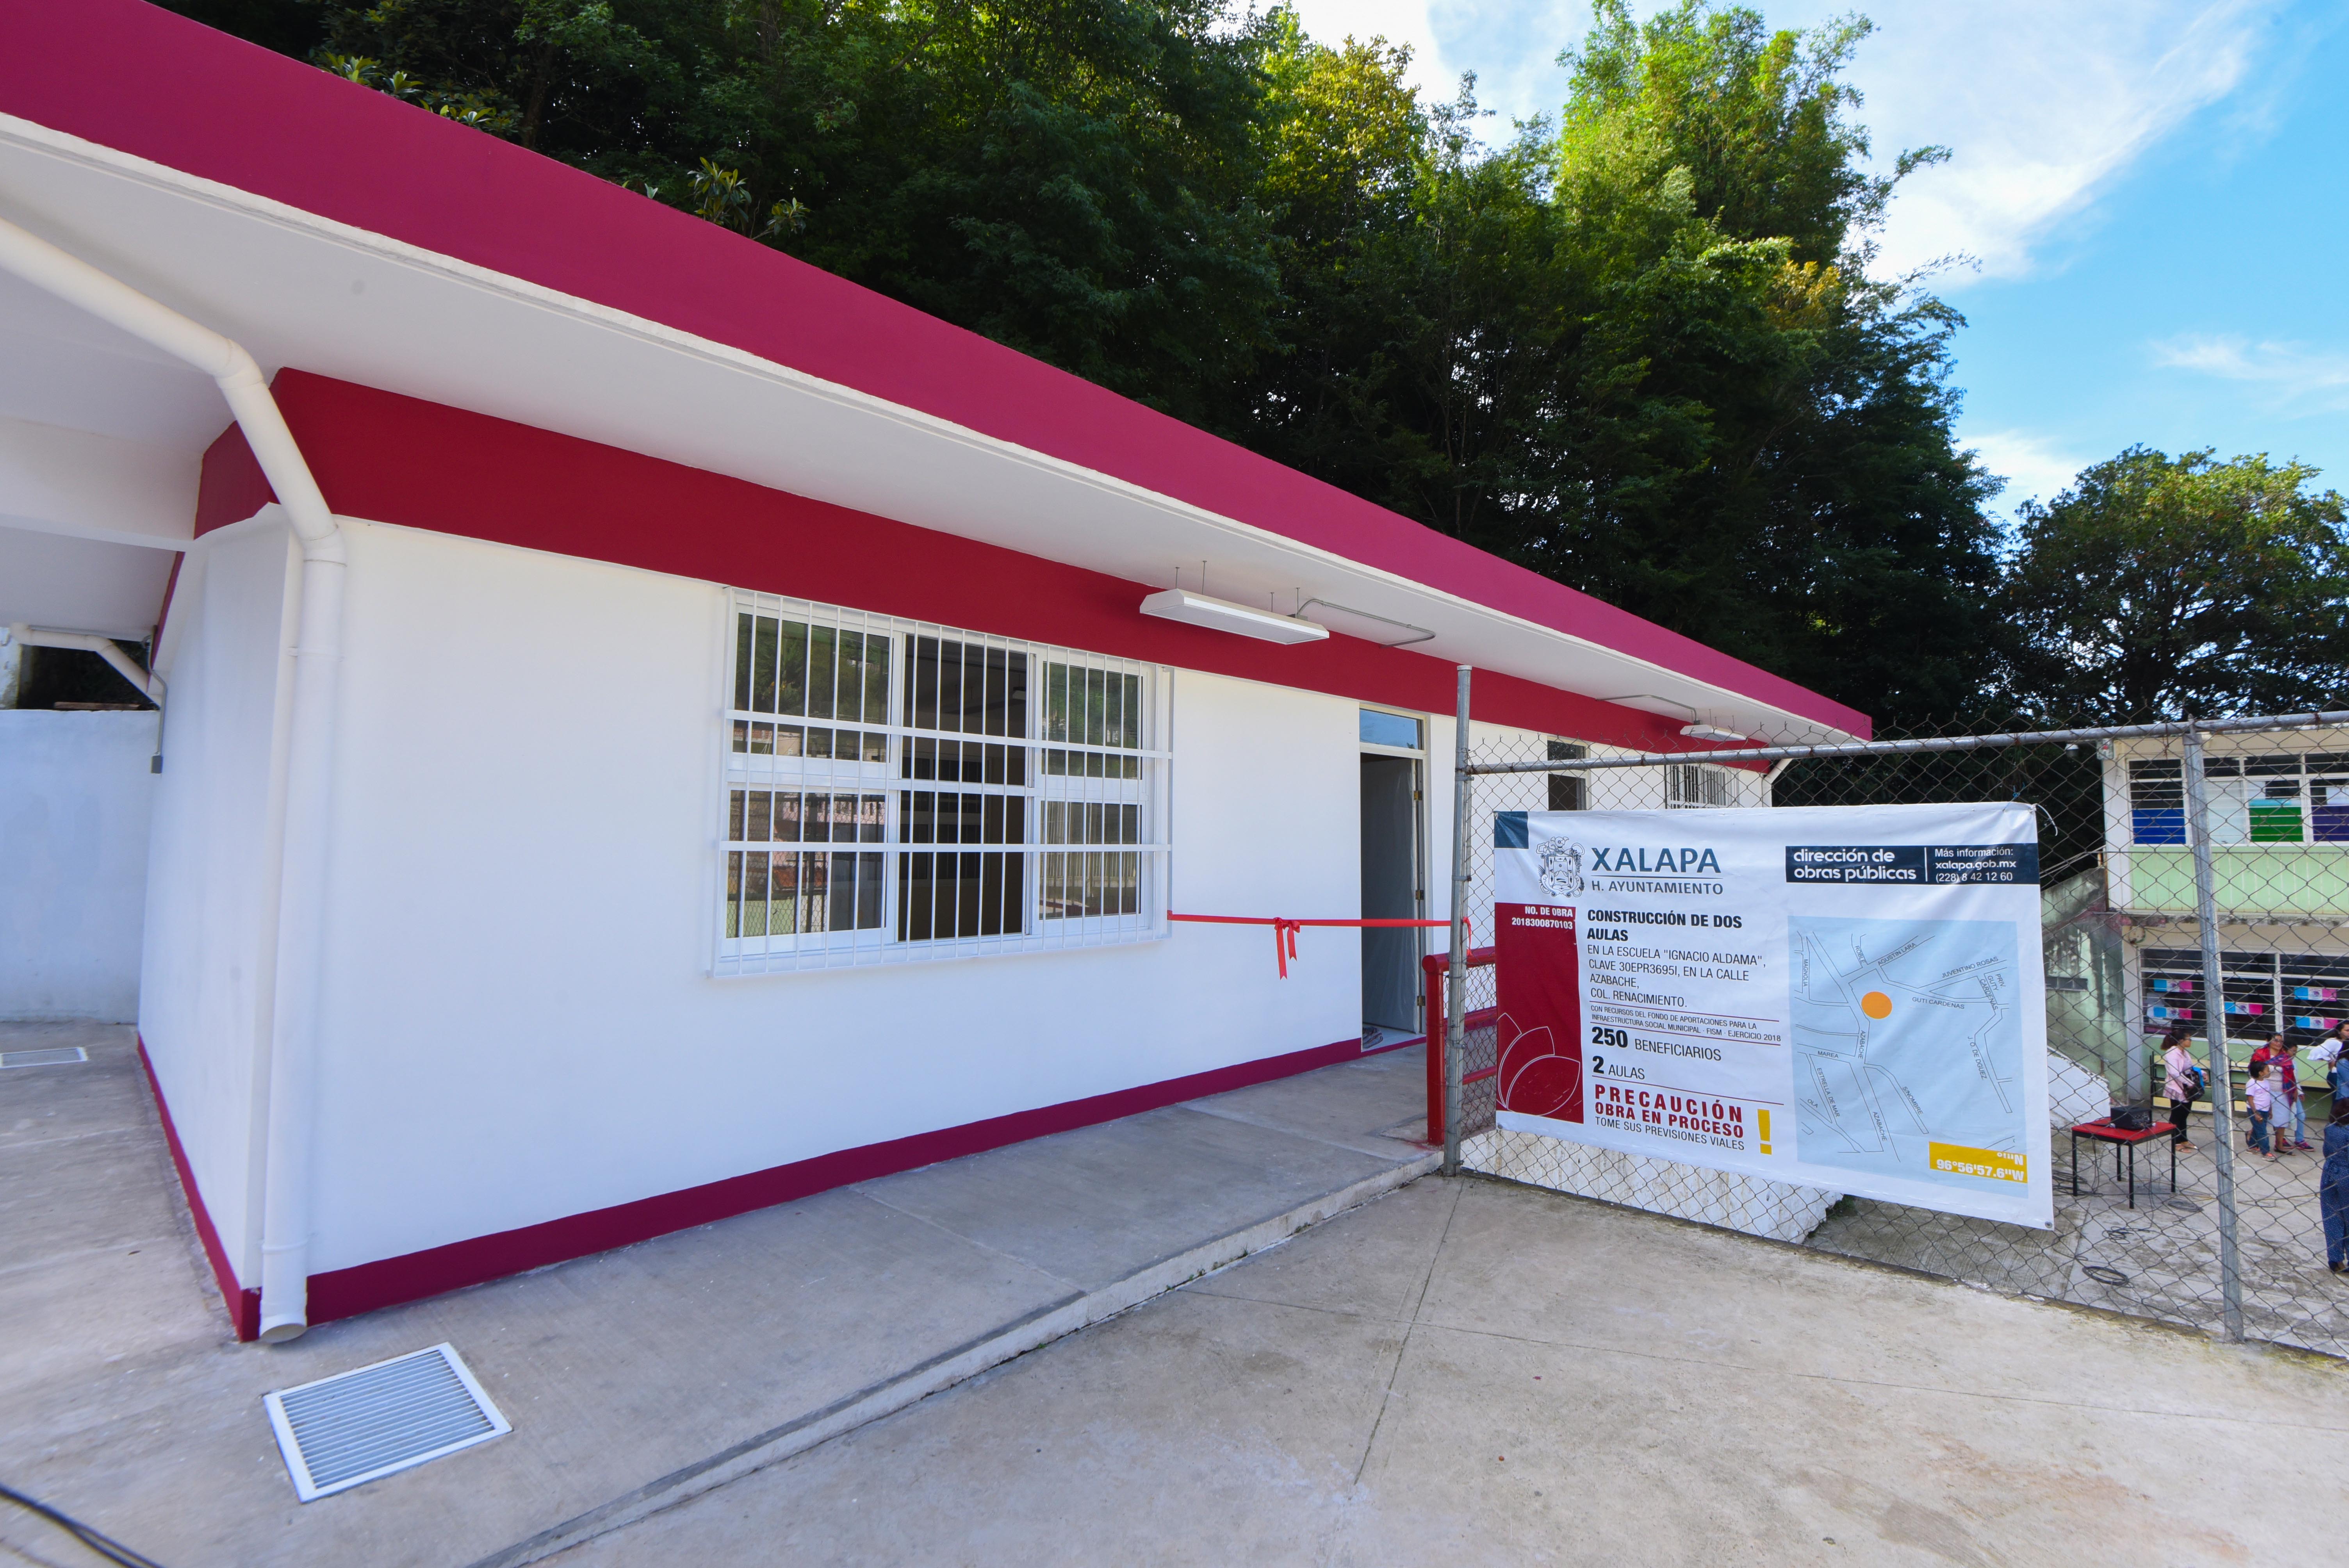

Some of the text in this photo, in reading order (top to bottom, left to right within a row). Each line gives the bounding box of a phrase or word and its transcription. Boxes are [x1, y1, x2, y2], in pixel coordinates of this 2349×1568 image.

[1591, 848, 1721, 873] XALAPA
[1793, 849, 1895, 862] dirección de
[1935, 847, 2013, 857] Más información:
[1794, 866, 1916, 882] obras públicas
[1936, 860, 2017, 871] xalapa.gob.mx
[1936, 872, 2012, 882] (228) 8 42 12 60
[1592, 881, 1723, 894] H. AYUNTAMIENTO
[1525, 906, 1573, 917] NO. DE OBRA
[1588, 909, 1742, 928] CONSTRUCCIÓN DE DOS
[1512, 918, 1573, 930] 2018300870103
[1587, 928, 1628, 941] AULAS
[1588, 945, 1599, 955] EN
[1602, 946, 1613, 955] LA
[1617, 947, 1660, 959] ESCUELA
[1664, 949, 1709, 962] "IGNACIO
[1855, 945, 1865, 964] ROBLE
[1878, 943, 1916, 966] AGUSTIN LARA
[1589, 959, 1616, 971] CLAVE
[1683, 967, 1696, 976] EN
[1700, 968, 1713, 978] LA
[1716, 969, 1749, 981] CALLE
[1942, 956, 1998, 978] JUVENTINO ROSAS
[1590, 973, 1640, 989] AZABACHE,
[1987, 975, 1999, 991] GUTY
[1590, 988, 1687, 1007] COL. RENACIMIENTO.
[1980, 978, 1998, 1010] CARDENAS
[1928, 999, 1965, 1009] CARDENAS
[1604, 1007, 1633, 1016] RECURSOS
[1648, 1012, 1668, 1021] FONDO
[1680, 1016, 1727, 1027] APORTACIONES
[1592, 1014, 1643, 1026] INFRAESTRUCTURA
[1645, 1021, 1666, 1030] SOCIAL
[1668, 1023, 1701, 1033] MUNICIPAL
[1707, 1028, 1722, 1036] FISM
[1728, 1030, 1761, 1040] EJERCICIO
[1592, 1026, 1722, 1061] 250 BENEFICIARIOS
[1818, 1050, 1839, 1058] MAREA
[1972, 1049, 1980, 1058] DE
[1592, 1055, 1645, 1080] 2 AULAS
[1975, 1058, 1987, 1080] DGUEZ
[1817, 1067, 1840, 1117] ESTRELLA DE MAR
[1902, 1086, 1923, 1115] S/NOMBRE
[1595, 1084, 1742, 1123] PRECAUCIÓN
[1807, 1099, 1818, 1108] OLA
[1595, 1102, 1743, 1138] OBRA EN PROCESO
[1873, 1111, 1887, 1142] AZABACHE
[1595, 1116, 1744, 1150] TOME SUS PREVISIONES VIALES
